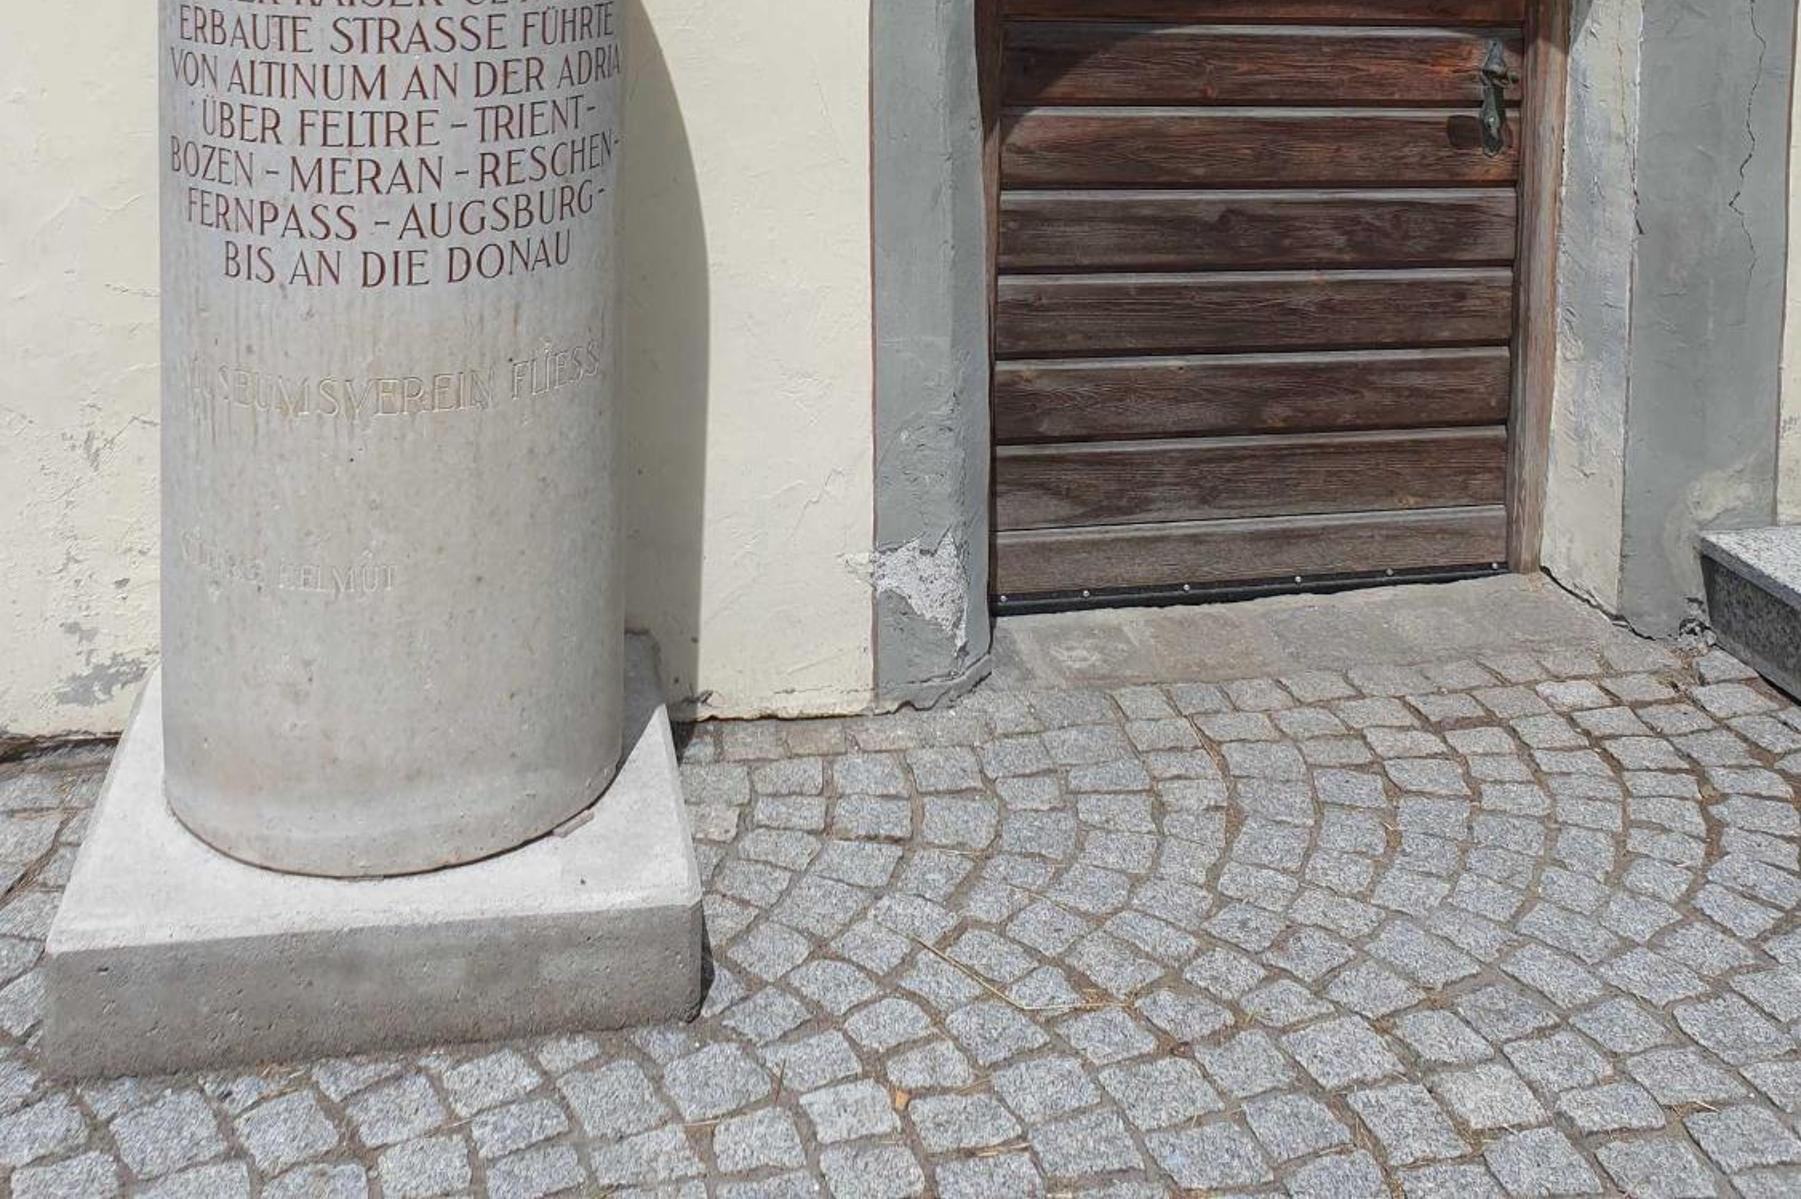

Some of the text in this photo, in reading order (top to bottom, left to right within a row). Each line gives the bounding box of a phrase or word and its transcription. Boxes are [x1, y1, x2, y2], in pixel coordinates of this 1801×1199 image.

[179, 1, 615, 55] ERBAUTE STRASSE FÜHRTE
[170, 44, 622, 101] VON ALTINUM AN DER ADRIA
[202, 95, 283, 145] ÜBER
[299, 110, 440, 147] FELTRE
[171, 135, 253, 187] BOZEN
[290, 156, 443, 196] MERAN
[187, 187, 358, 241] FERNPASS
[223, 229, 571, 288] BIS AN DIE DONAU
